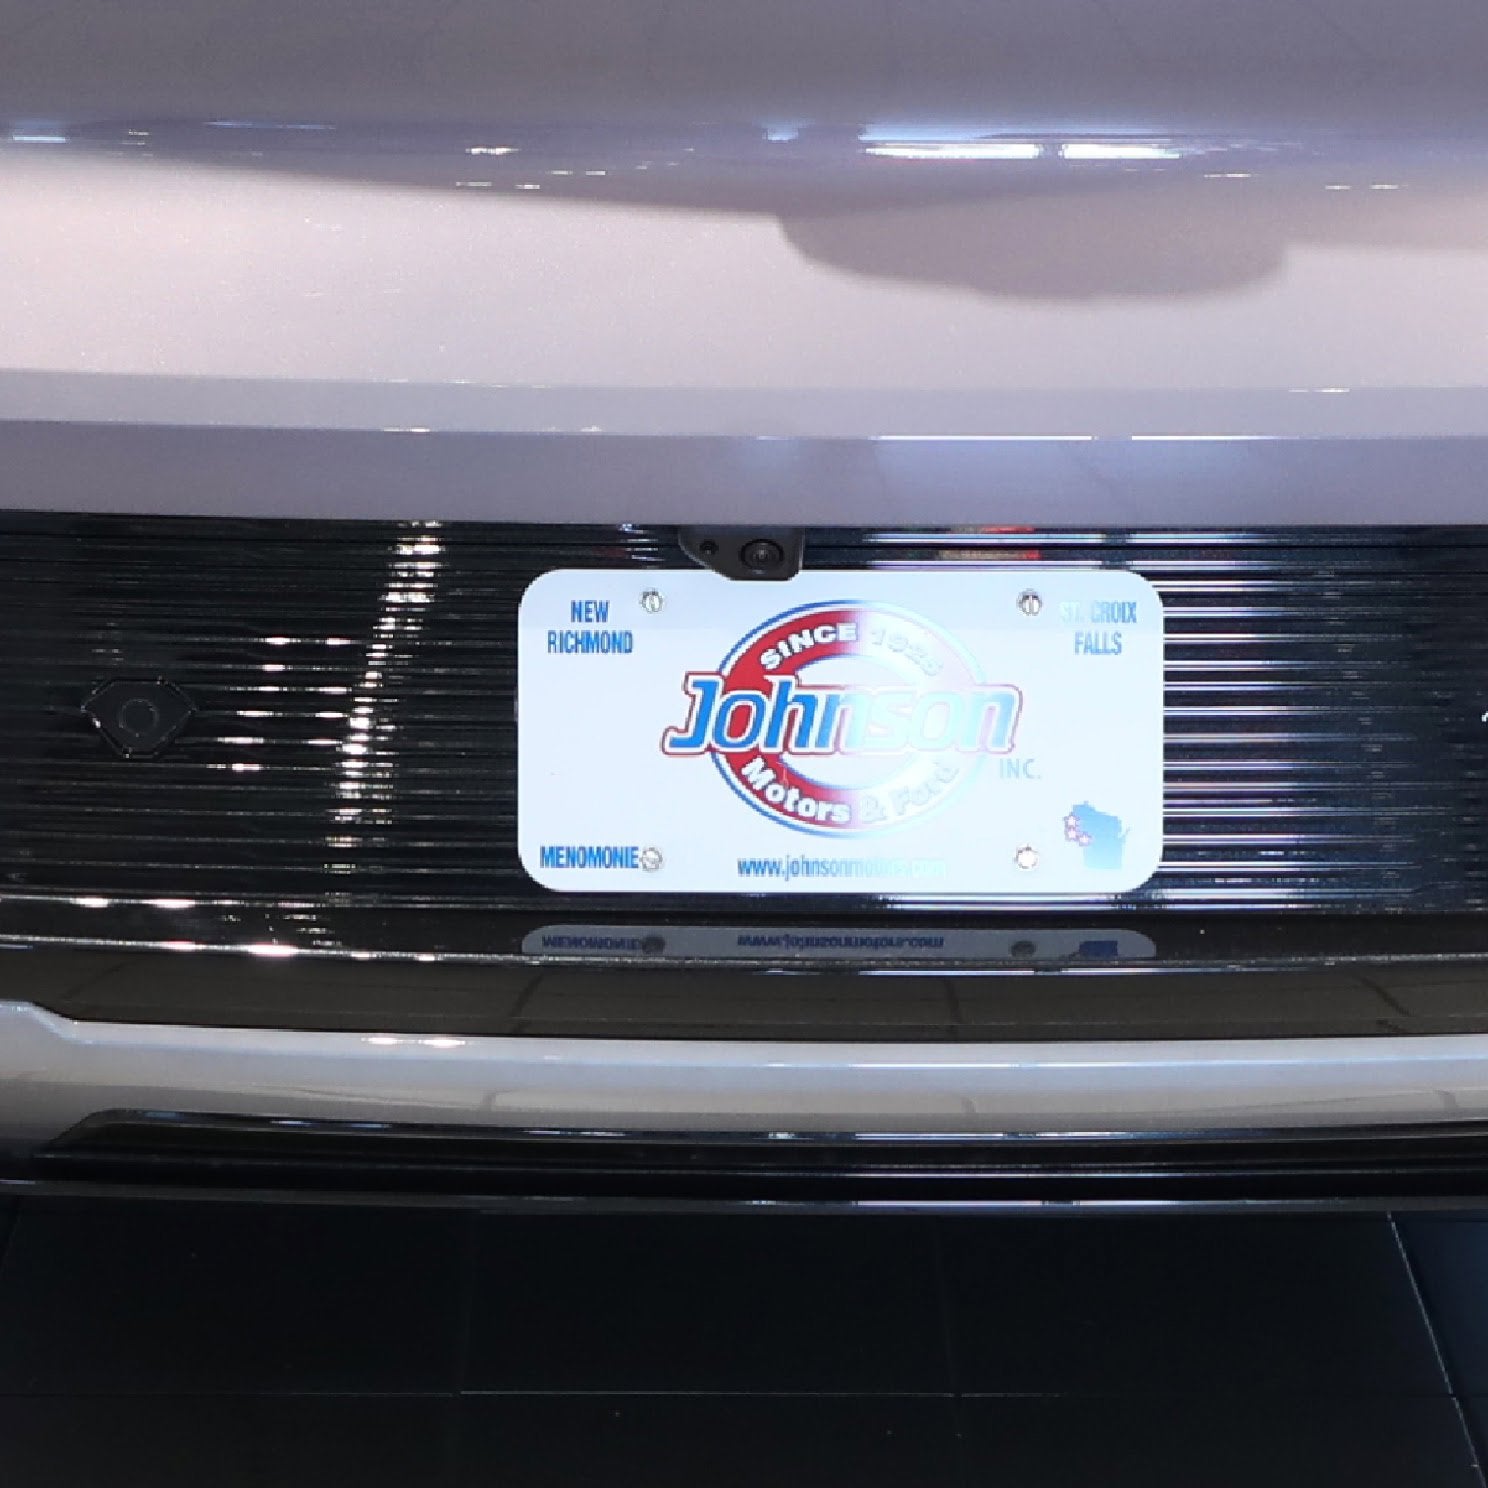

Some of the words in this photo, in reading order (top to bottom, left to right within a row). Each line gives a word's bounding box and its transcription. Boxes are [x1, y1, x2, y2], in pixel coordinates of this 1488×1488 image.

[570, 599, 610, 623] NEW
[1090, 600, 1137, 623] CROIX
[547, 629, 633, 654] RICHMOND
[760, 622, 858, 670] SINCE
[1074, 631, 1122, 655] FALLS
[664, 673, 1021, 754] Johnson
[998, 758, 1042, 780] INC.
[741, 758, 852, 823] Motors
[539, 845, 639, 869] MENOMONIE
